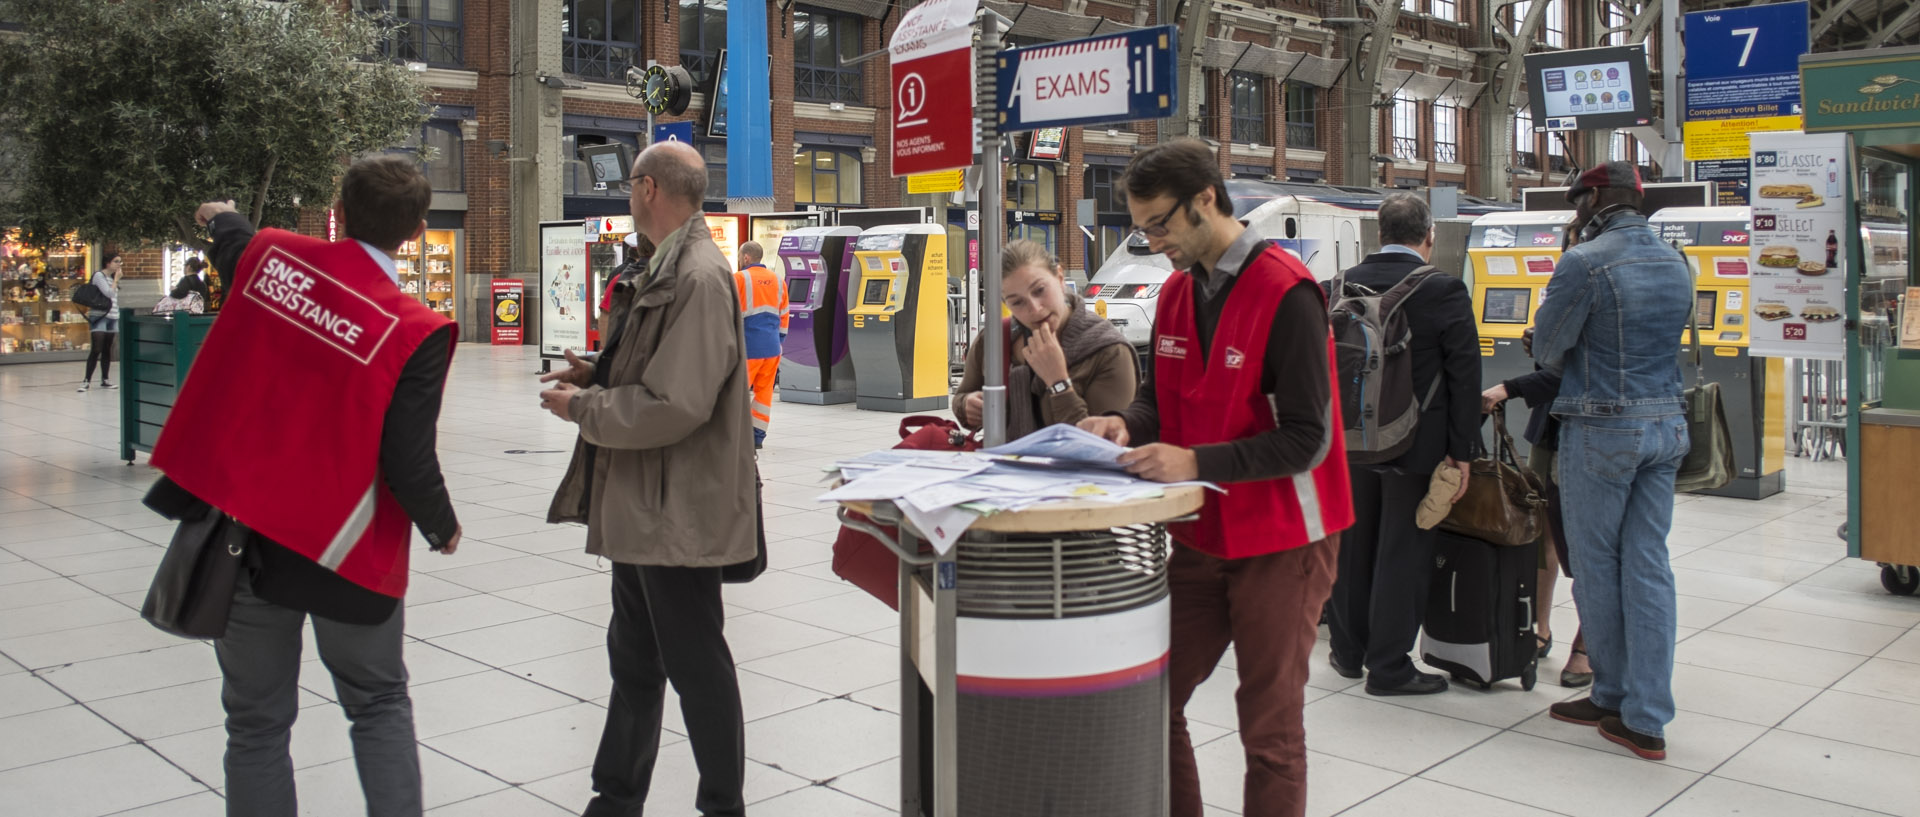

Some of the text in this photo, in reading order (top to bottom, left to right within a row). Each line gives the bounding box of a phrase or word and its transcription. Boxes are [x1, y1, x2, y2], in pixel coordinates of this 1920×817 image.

[894, 39, 927, 54] EXAMS
[1731, 27, 1759, 67] 7
[1035, 69, 1110, 100] EXAMS
[1689, 107, 1733, 117] Compostez
[1757, 104, 1779, 112] Billet
[896, 135, 931, 148] NOS AGENTS
[896, 148, 911, 157] VOUS
[1779, 154, 1824, 168] CLASSIC
[1778, 219, 1814, 232] SELECT
[263, 258, 315, 291] SNCF
[253, 275, 363, 345] ASSISTANCE
[1160, 346, 1187, 355] ASSISTAN
